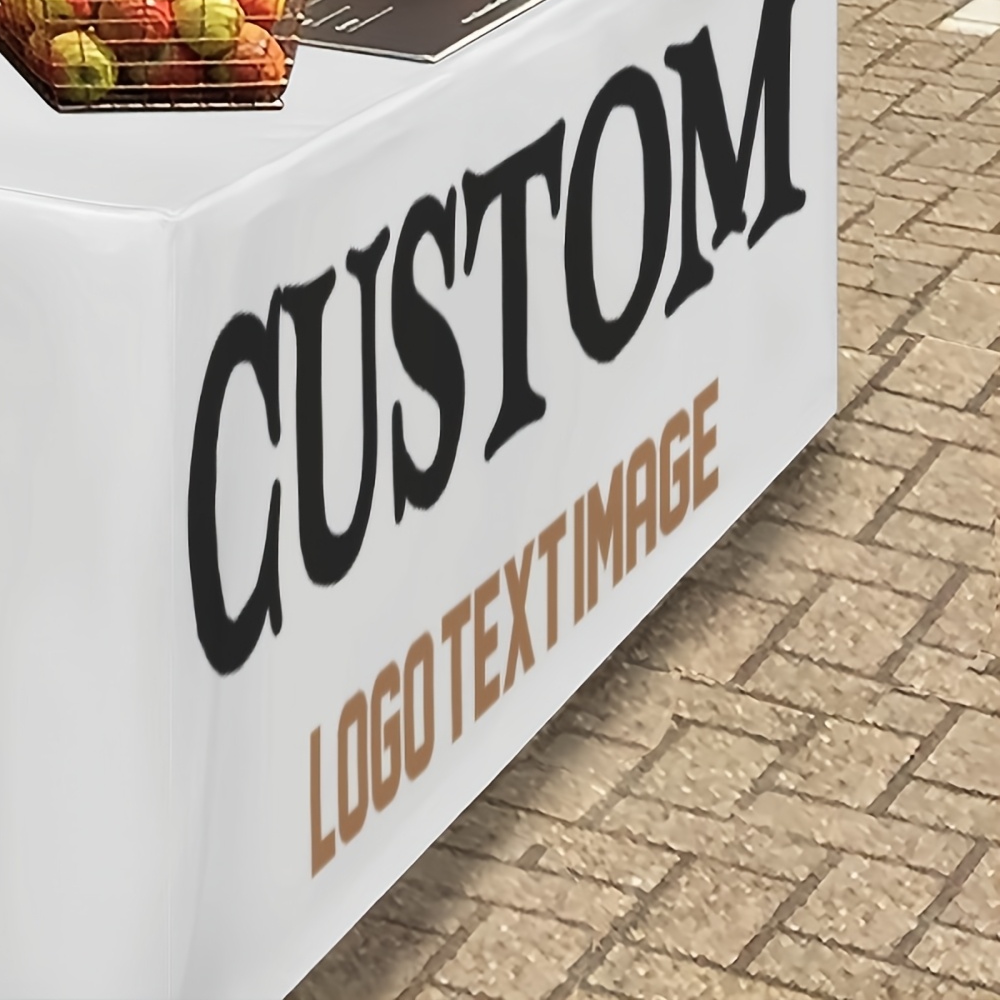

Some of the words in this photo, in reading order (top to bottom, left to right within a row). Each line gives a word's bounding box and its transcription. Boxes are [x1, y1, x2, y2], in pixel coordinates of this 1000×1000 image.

[310, 630, 435, 877] LOGO
[441, 515, 567, 744] TEXT
[574, 377, 720, 623] IMAGE
